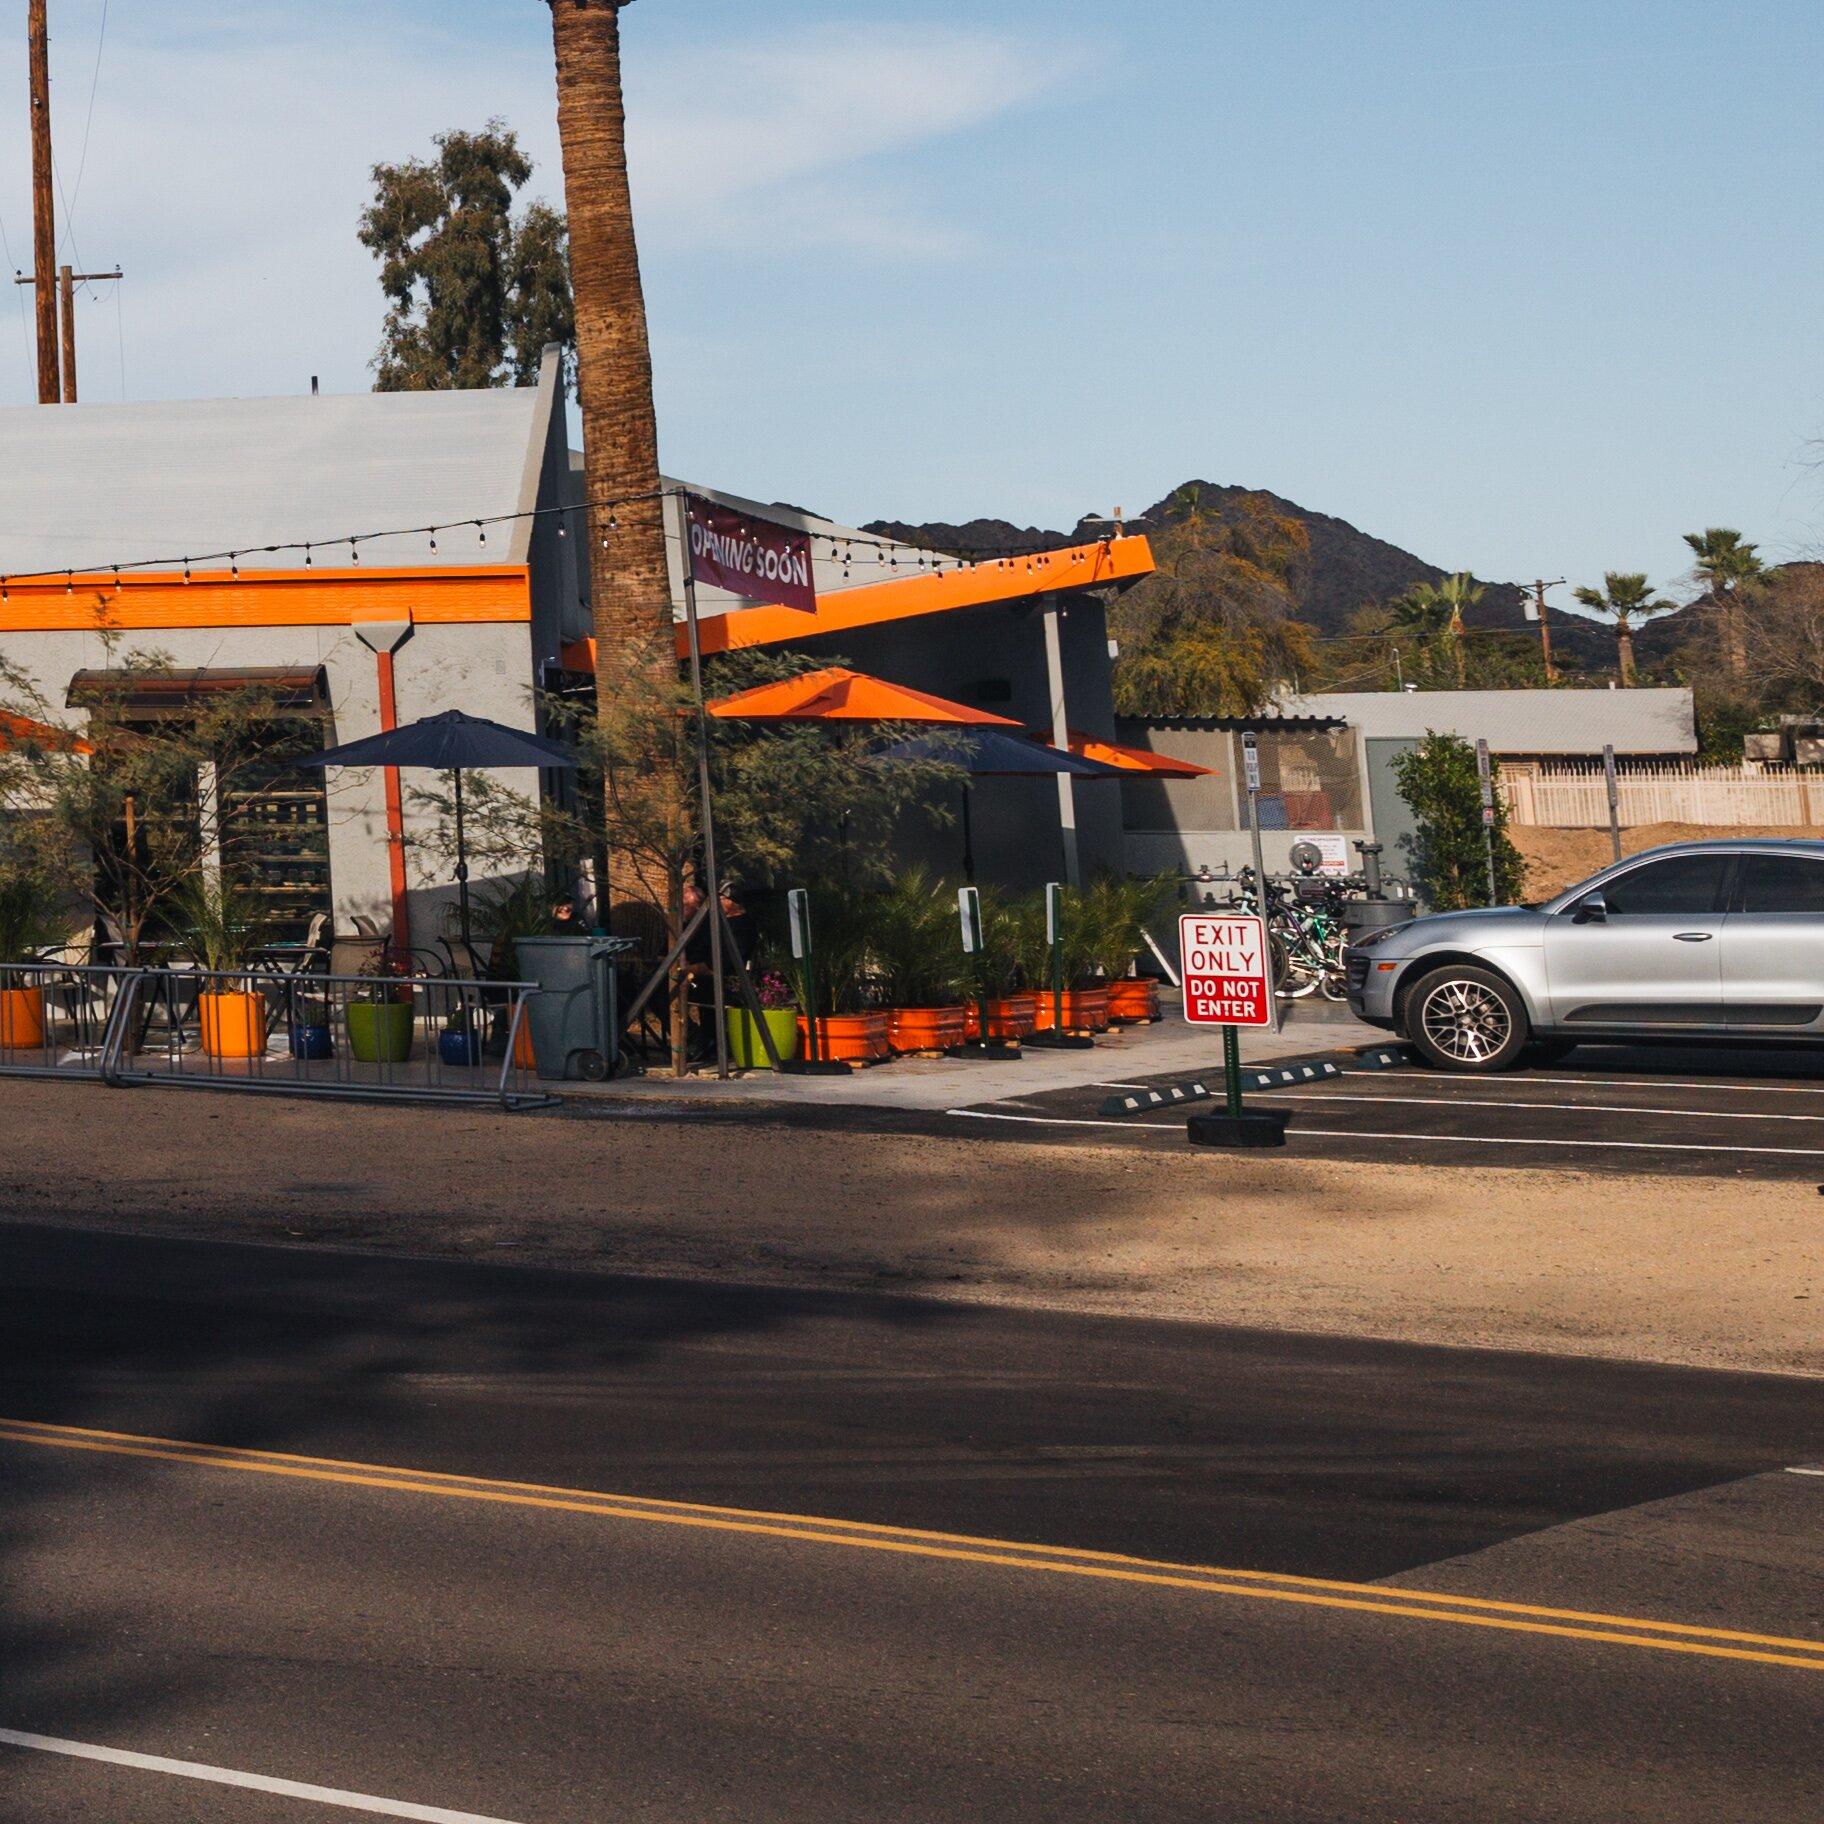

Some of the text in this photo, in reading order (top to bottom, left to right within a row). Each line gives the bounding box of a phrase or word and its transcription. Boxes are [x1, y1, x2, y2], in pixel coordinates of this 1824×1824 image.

[755, 546, 808, 587] SOON
[1195, 925, 1247, 945] EXIT
[1192, 950, 1254, 972] ONLY
[1191, 979, 1260, 997] DO NOT
[1196, 999, 1256, 1017] ENTER
